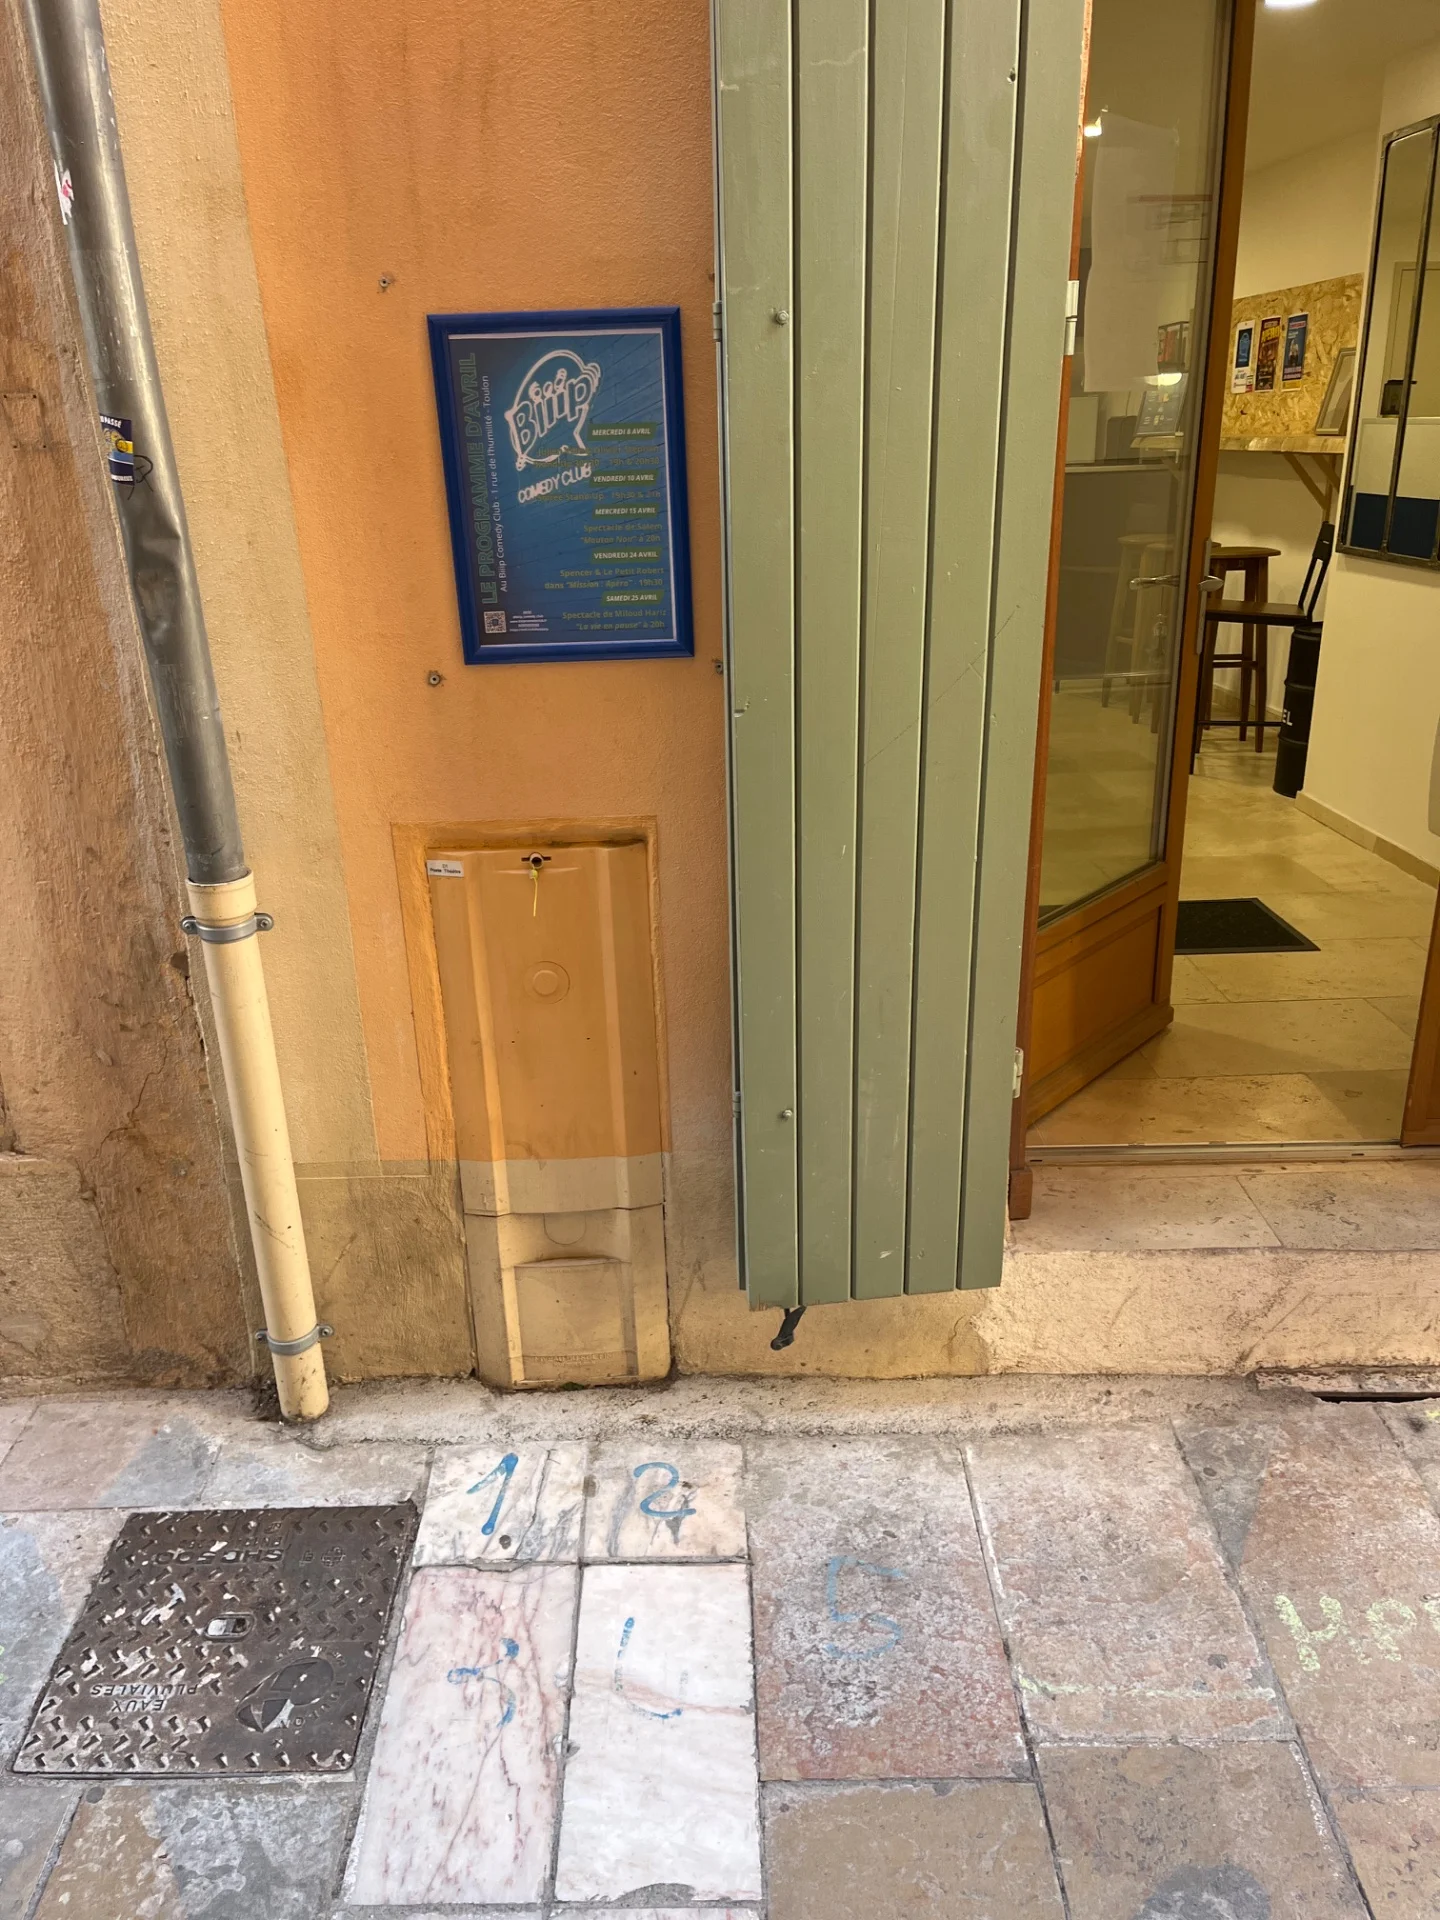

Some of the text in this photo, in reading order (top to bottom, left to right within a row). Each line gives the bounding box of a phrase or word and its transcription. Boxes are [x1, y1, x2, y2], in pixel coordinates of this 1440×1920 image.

[481, 375, 491, 408] Toulon
[592, 428, 626, 436] MERCREDI
[632, 427, 651, 435] AVRIL
[489, 458, 497, 470] de
[490, 471, 498, 487] rue
[518, 463, 593, 503] COMEDY CLUB
[593, 475, 626, 483] VENDREDI
[467, 443, 494, 577] PROGRAMME
[492, 501, 501, 521] Club
[583, 523, 622, 533] Spectacle
[495, 523, 505, 559] Comedy
[646, 534, 661, 542] 20h
[559, 568, 593, 578] Spencer
[615, 567, 635, 575] Petit
[636, 566, 664, 575] Robert
[499, 580, 508, 592] Au
[544, 581, 564, 589] dans
[639, 578, 663, 586] 19h30
[481, 581, 498, 604] LE
[562, 610, 601, 620] Spectacle
[603, 610, 613, 618] de
[590, 622, 601, 630] vie
[603, 622, 614, 630] en
[649, 620, 665, 629] 20h
[467, 1452, 519, 1536] 1
[633, 1461, 697, 1518] 2
[822, 1554, 908, 1660] 5
[90, 1683, 198, 1696] PLUVIALES
[446, 1637, 520, 1730] 3
[110, 1699, 165, 1713] EAUX
